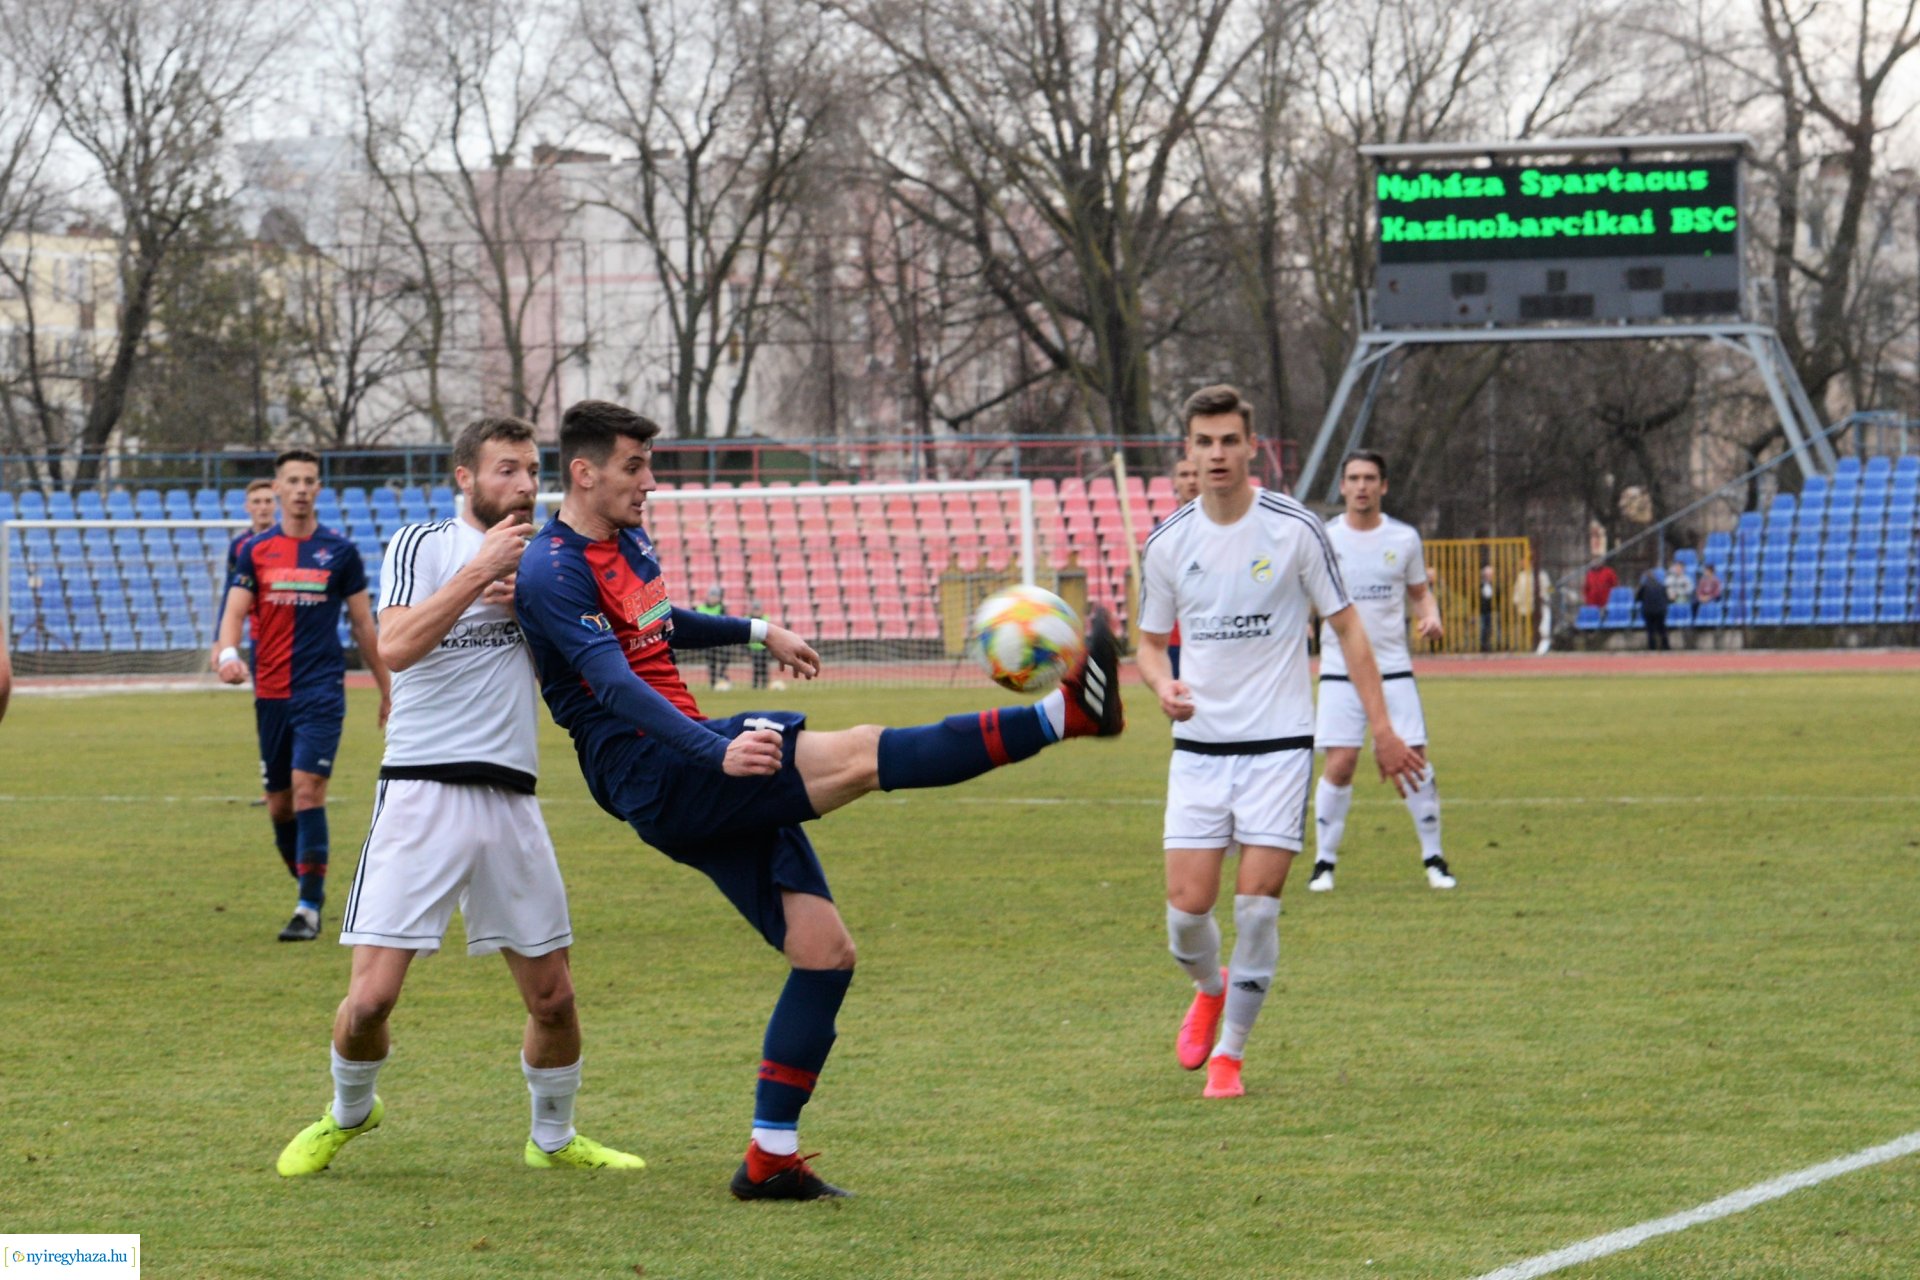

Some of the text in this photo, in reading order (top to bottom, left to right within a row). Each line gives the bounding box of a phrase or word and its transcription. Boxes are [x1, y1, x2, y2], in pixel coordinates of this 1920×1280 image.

[1376, 168, 1709, 202] Nyháza Spartacus
[1380, 206, 1738, 242] Kazincbarcikai BSC
